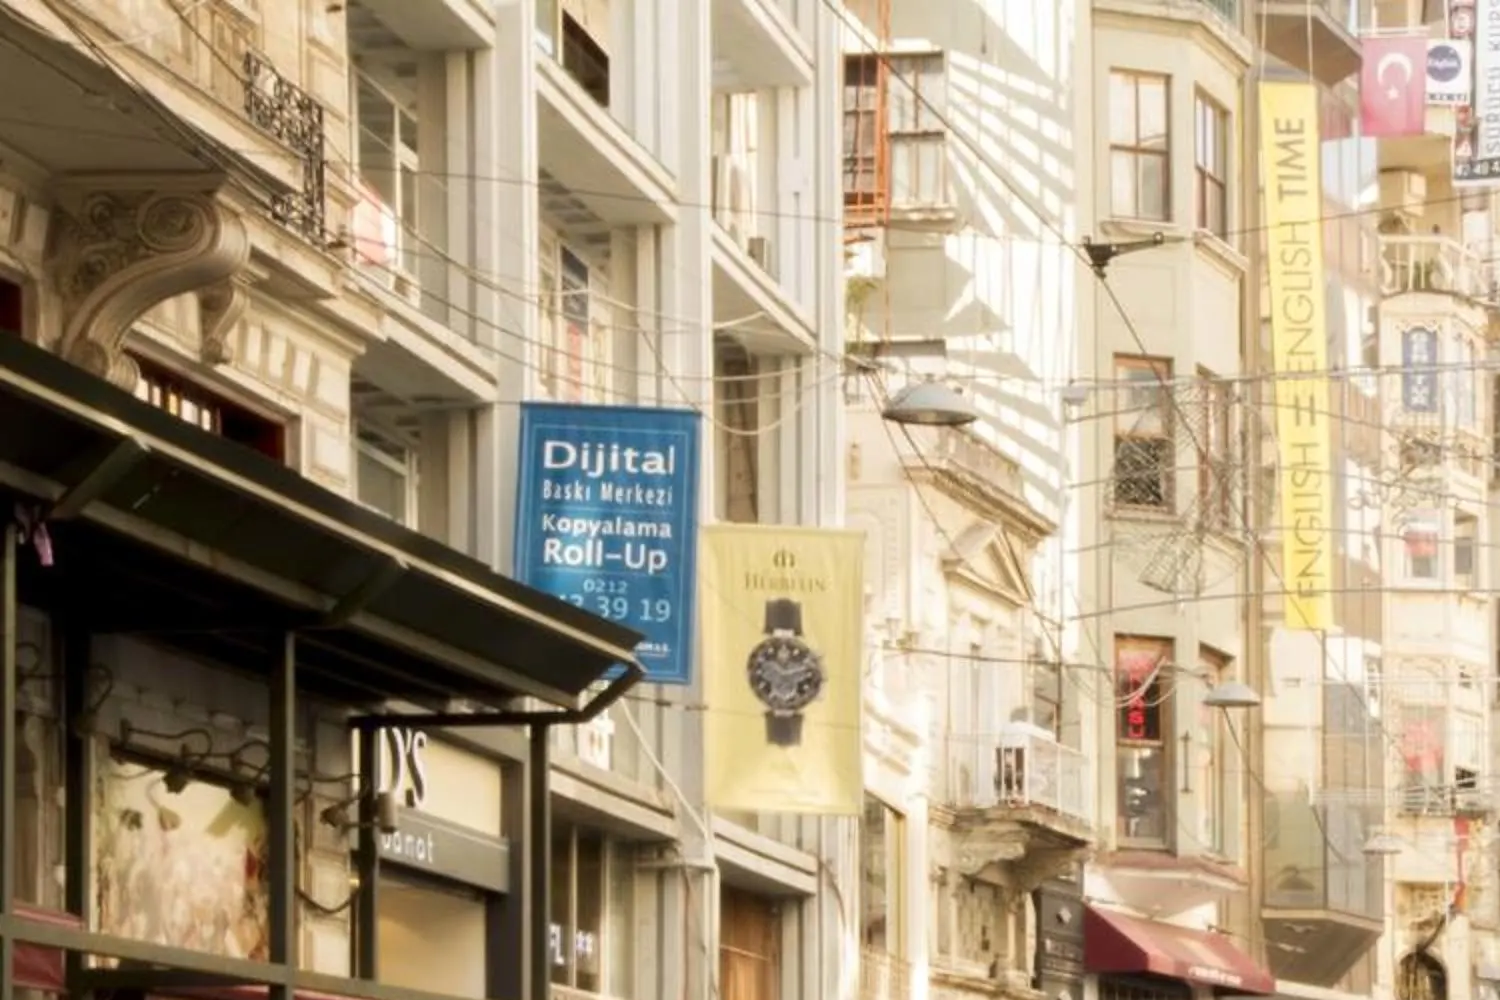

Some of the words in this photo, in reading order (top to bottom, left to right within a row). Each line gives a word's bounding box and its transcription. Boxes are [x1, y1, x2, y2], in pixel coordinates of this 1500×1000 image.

[1274, 118, 1308, 203] TIME
[543, 440, 675, 477] Dijital
[601, 482, 673, 505] Merkezi
[542, 514, 672, 539] Kopyalama
[543, 539, 668, 575] Roll-Up
[583, 579, 628, 594] 0212
[639, 598, 671, 622] 19
